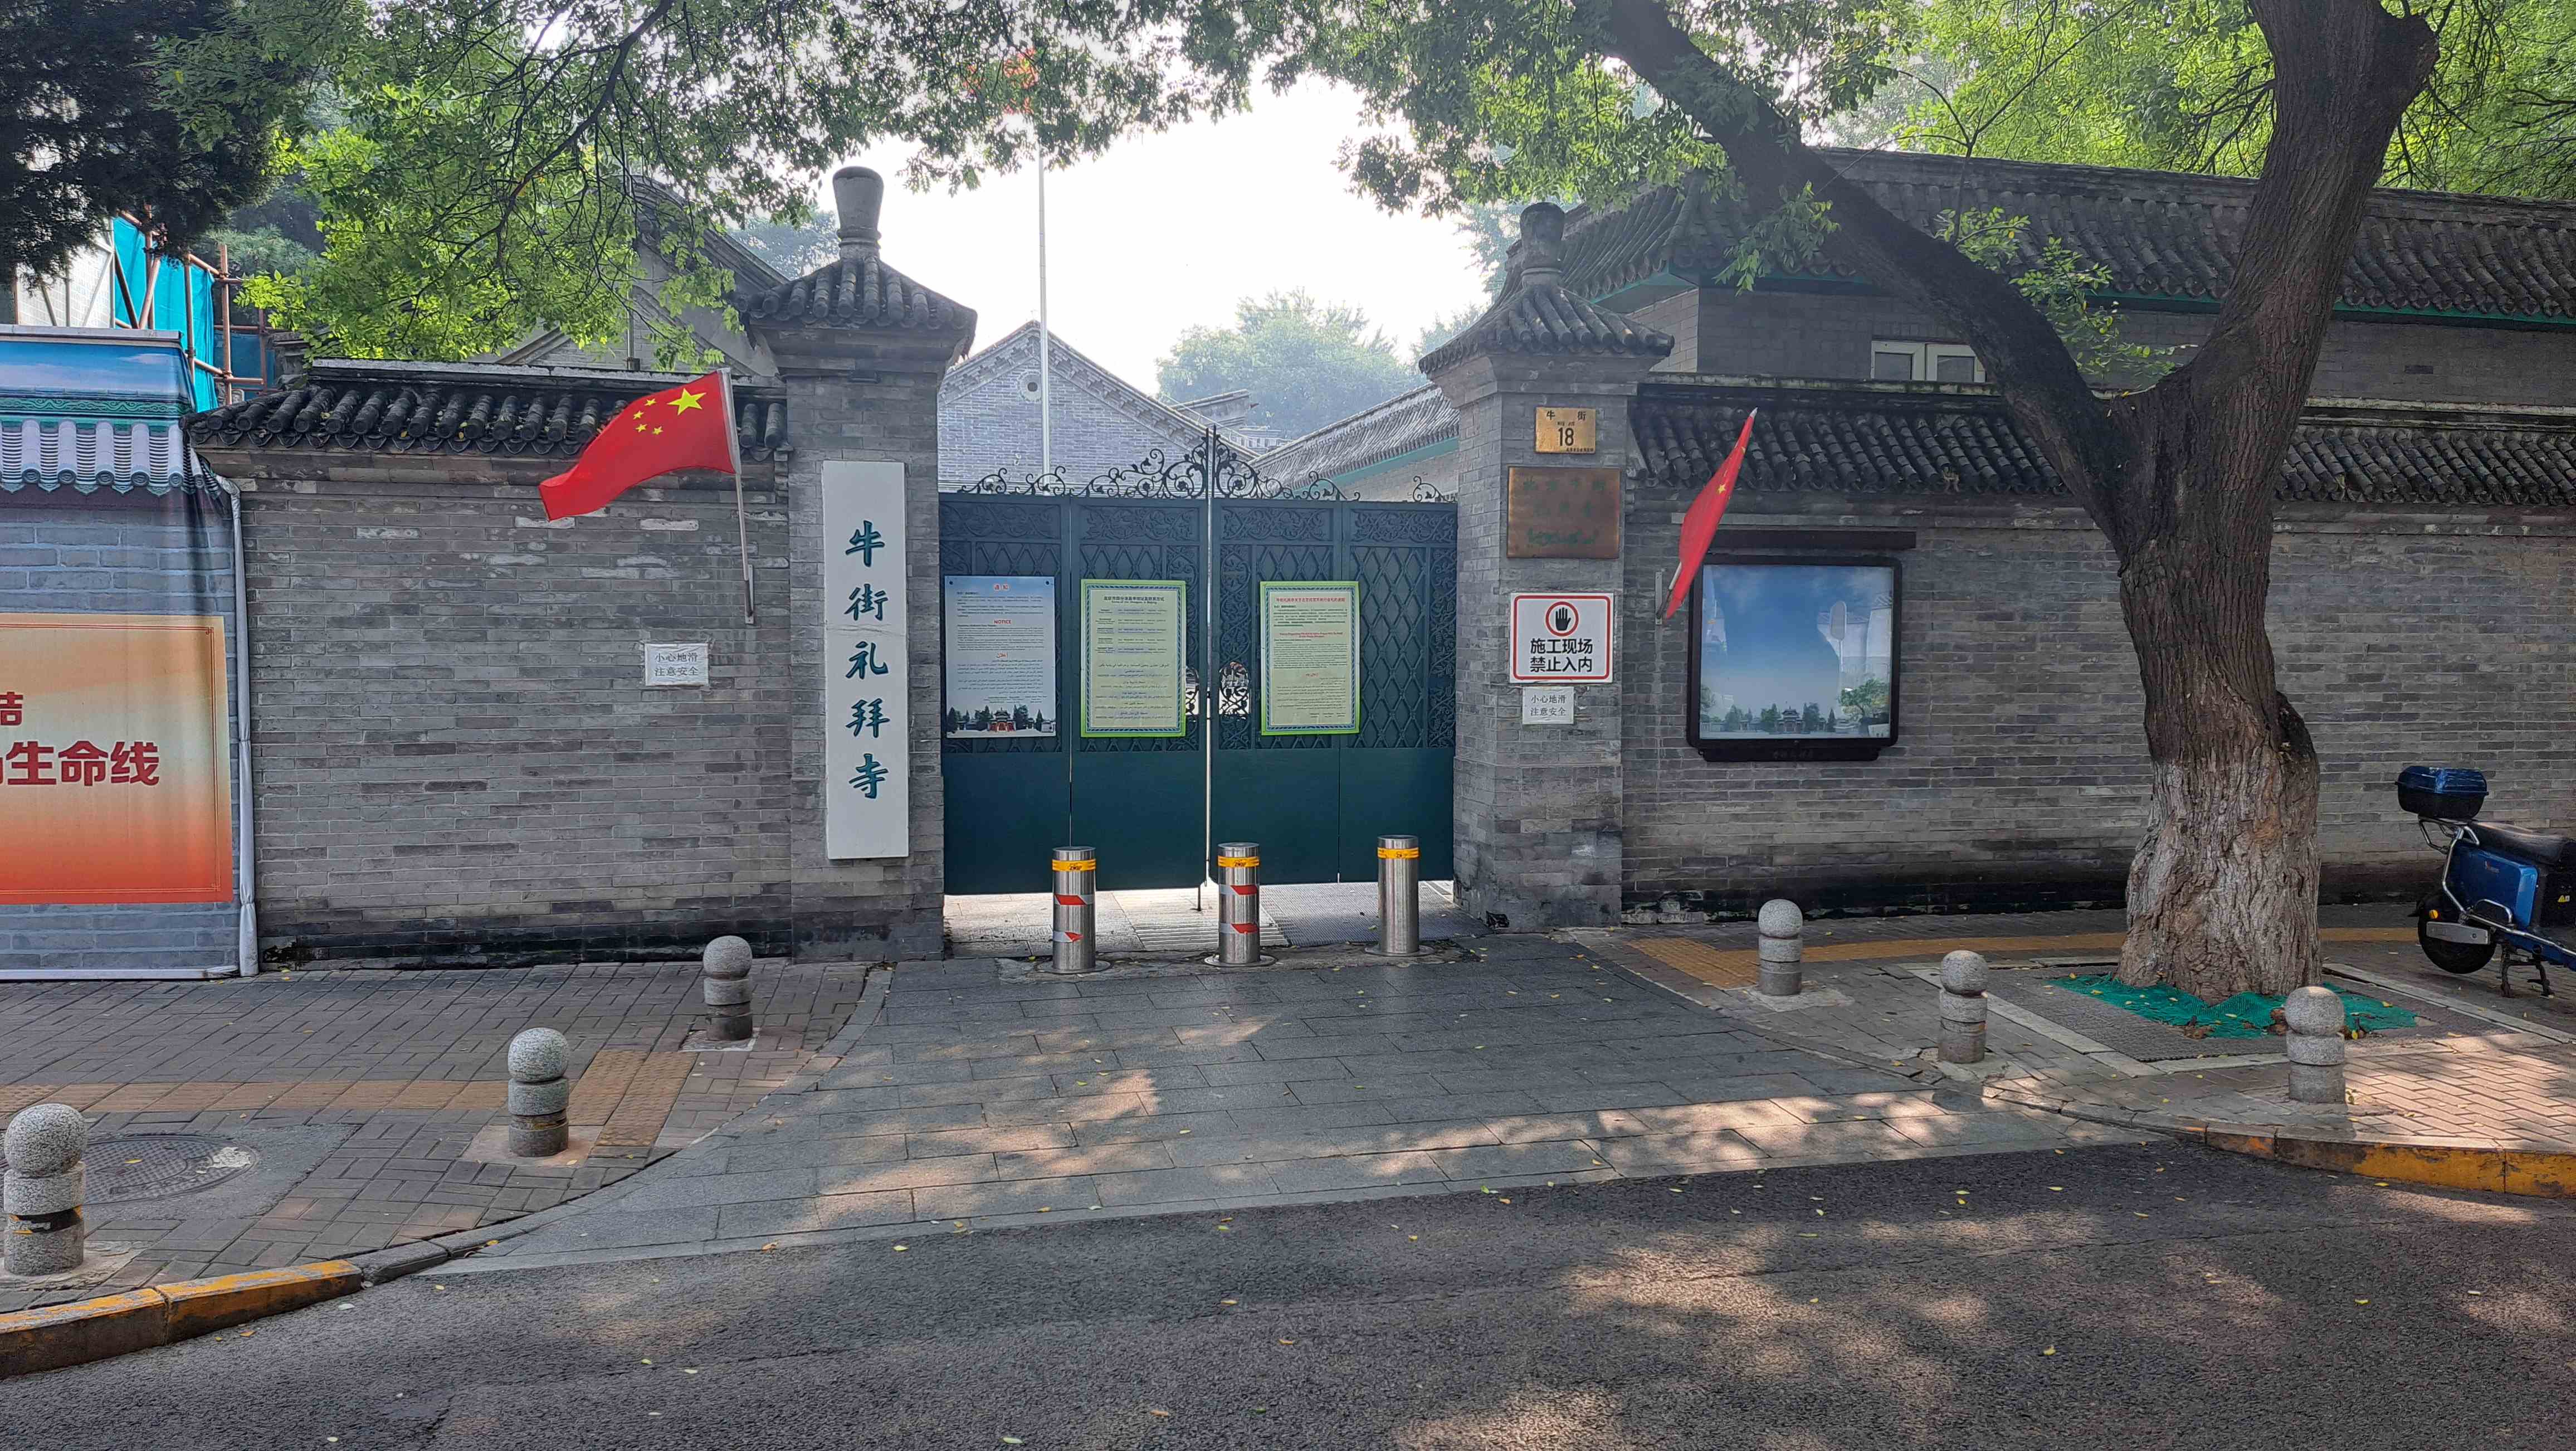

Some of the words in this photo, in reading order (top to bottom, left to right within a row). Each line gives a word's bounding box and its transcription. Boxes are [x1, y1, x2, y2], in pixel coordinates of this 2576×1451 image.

[1558, 427, 1574, 446] 18
[1530, 638, 1593, 655] 施工现场
[655, 653, 698, 662] 小心地滑
[845, 520, 890, 800] 牛街礼拜寺
[1530, 656, 1592, 673] 禁止入内
[655, 666, 699, 676] 注意安全
[1531, 695, 1566, 704] 小心地滑
[1530, 707, 1567, 716] 注意安全
[0, 741, 160, 787] 生命线
